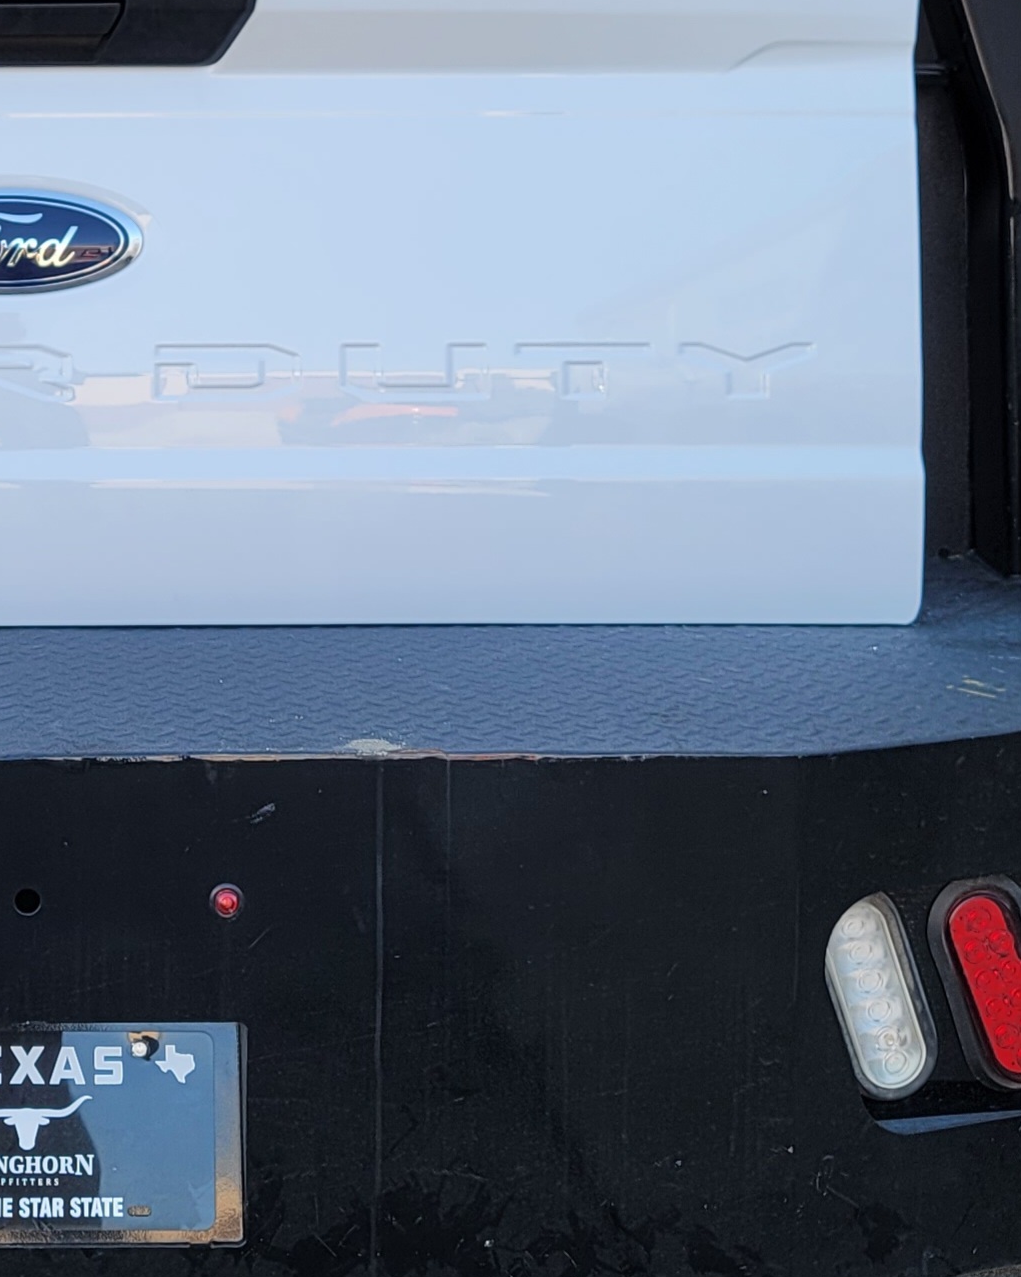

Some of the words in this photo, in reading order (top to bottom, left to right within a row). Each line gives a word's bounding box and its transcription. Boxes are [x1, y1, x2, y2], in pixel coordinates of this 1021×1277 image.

[153, 342, 818, 404] DUTY
[18, 1196, 65, 1218] STAR
[69, 1196, 124, 1218] STATE
